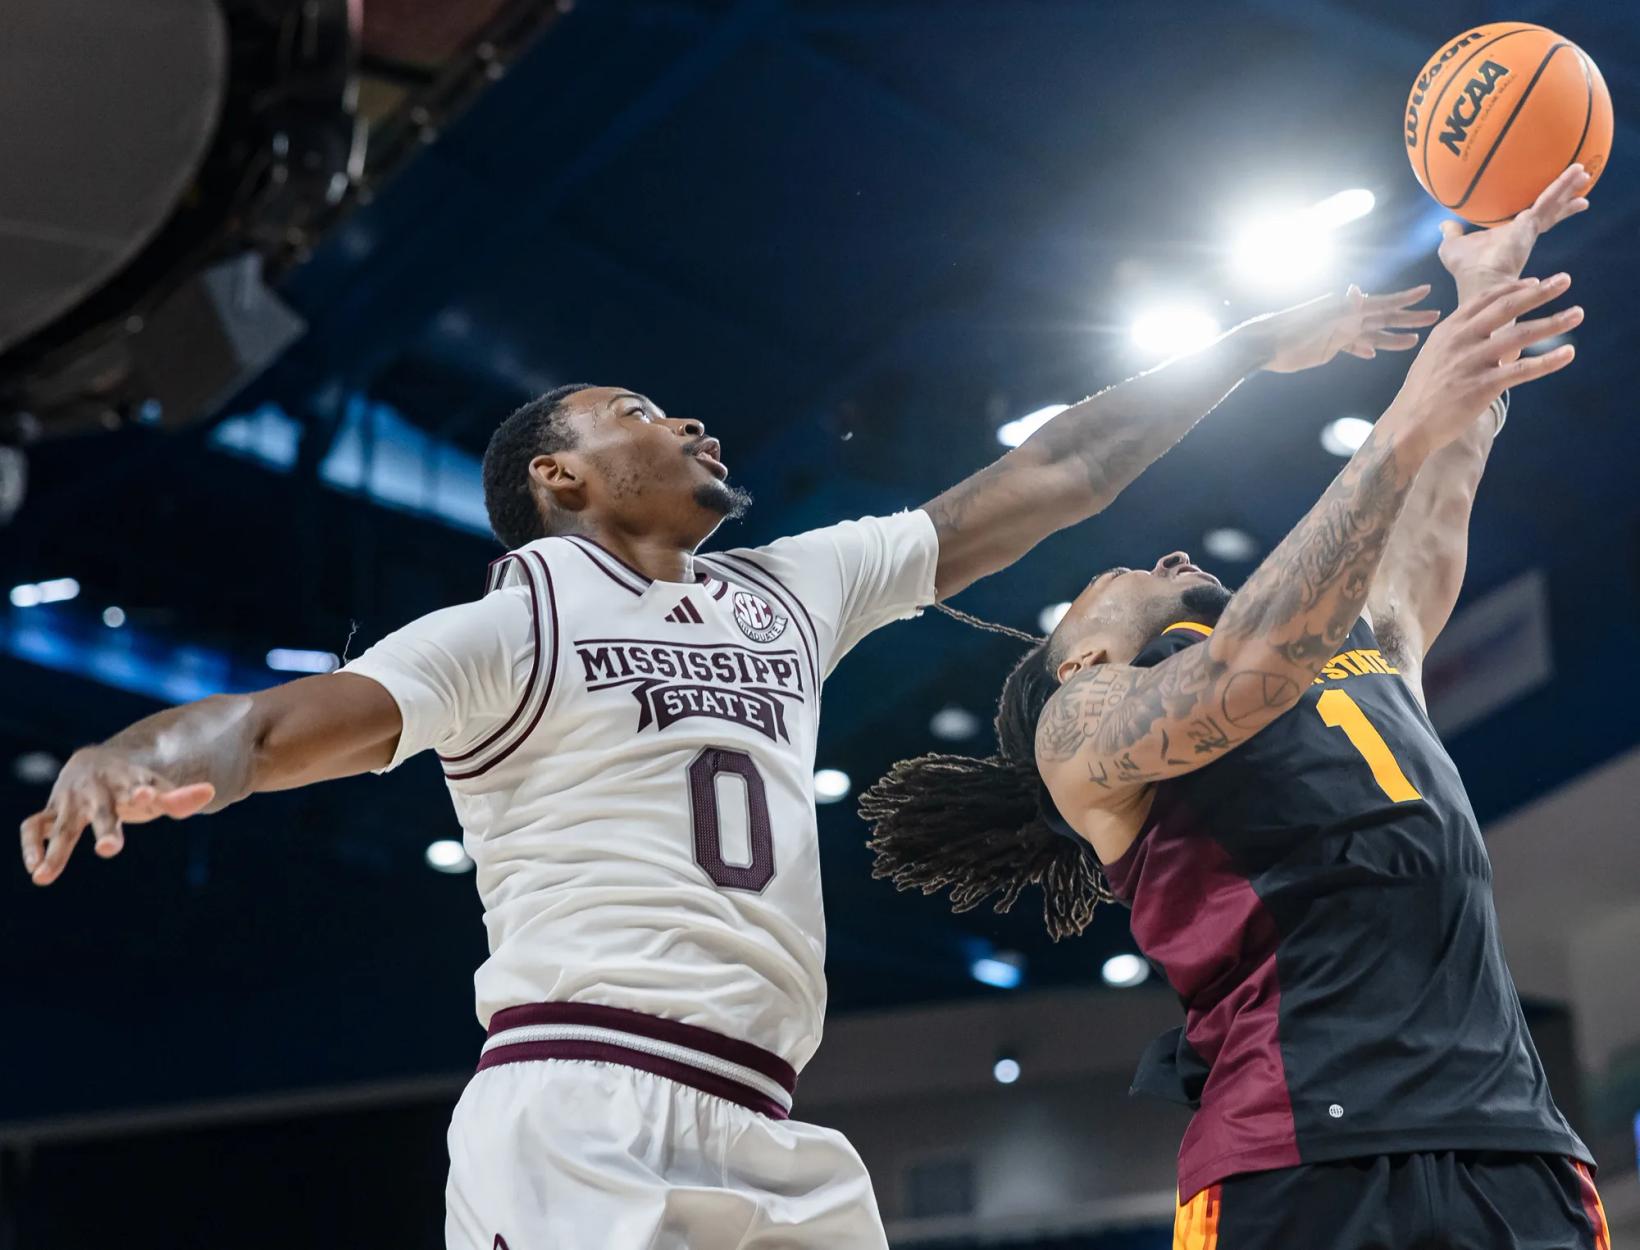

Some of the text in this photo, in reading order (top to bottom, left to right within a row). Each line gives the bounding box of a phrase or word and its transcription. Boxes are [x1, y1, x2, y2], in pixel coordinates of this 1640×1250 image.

[1407, 33, 1483, 148] Wilson
[1439, 60, 1509, 157] NCAA
[735, 592, 771, 629] SEC
[577, 646, 804, 693] MISSISSIPPI
[1082, 664, 1119, 738] CHIL
[1321, 649, 1401, 680] STATE
[663, 689, 765, 728] STATE
[1316, 688, 1422, 803] 1
[685, 744, 776, 896] 0
